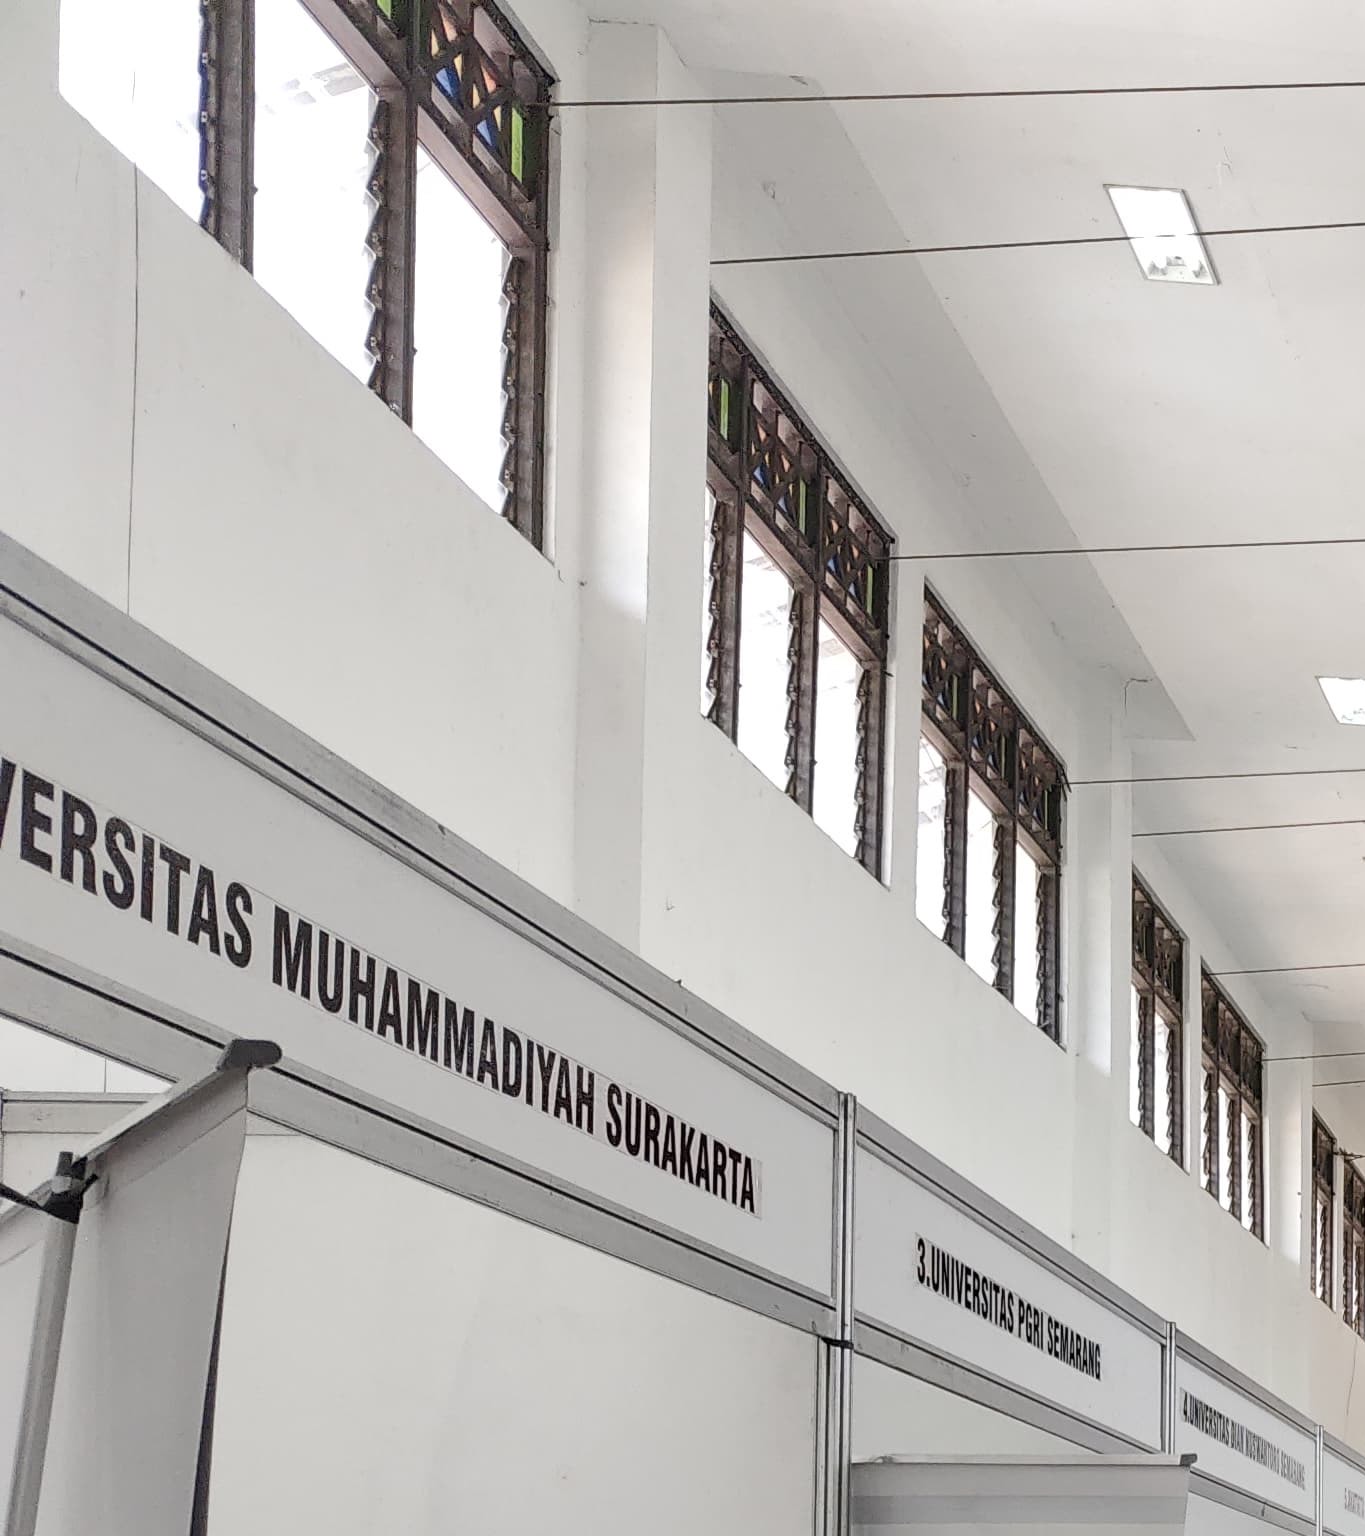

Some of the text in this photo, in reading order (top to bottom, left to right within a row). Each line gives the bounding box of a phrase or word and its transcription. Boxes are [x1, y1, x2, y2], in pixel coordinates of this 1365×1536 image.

[272, 904, 596, 1133] MUHAMMADIYAH
[606, 1083, 757, 1214] SURAKARTA
[917, 1238, 1101, 1381] 3.UNIVERSITAS PGRI SEMARANG
